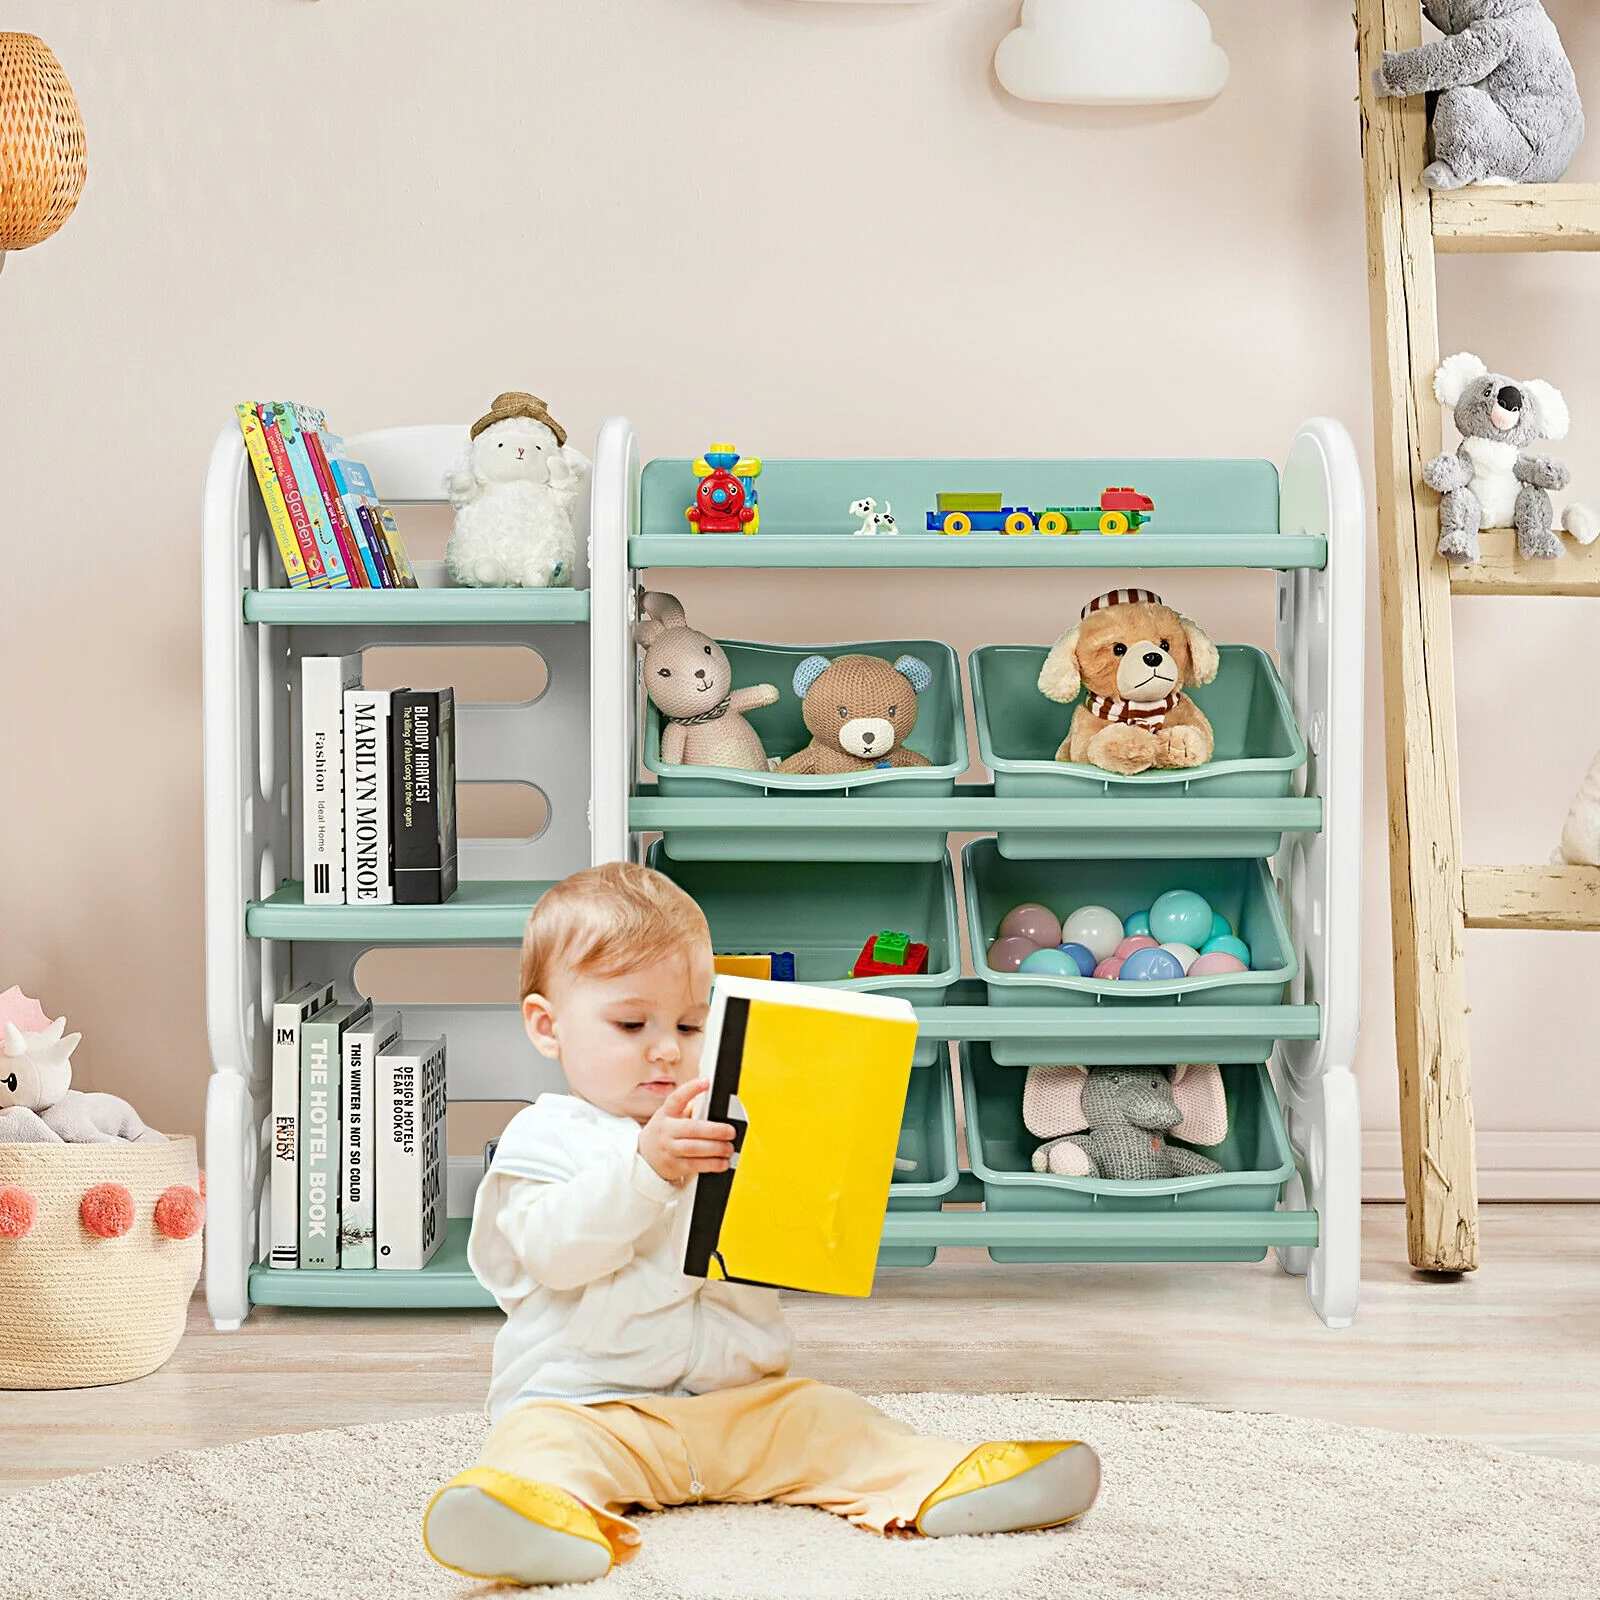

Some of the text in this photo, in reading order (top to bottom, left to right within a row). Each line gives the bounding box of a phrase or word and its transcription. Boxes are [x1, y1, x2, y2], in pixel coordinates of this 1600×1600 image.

[284, 475, 293, 489] the
[264, 481, 291, 549] animal homes
[285, 490, 312, 548] garden
[315, 732, 327, 792] Fashion
[402, 706, 413, 828] The killing of Falun Gong for their organs
[414, 706, 430, 803] BLOODY HARVEST
[318, 800, 326, 852] Ideal Home
[354, 703, 379, 900] MARILYN MONROE
[277, 1029, 294, 1042] IM
[350, 1043, 362, 1067] THIS
[350, 1069, 362, 1110] WINTER
[393, 1066, 404, 1095] YEAR
[422, 1046, 446, 1098] DESIGN
[350, 1113, 362, 1124] IS
[403, 1066, 414, 1153] DESIGN HOTELS
[422, 1082, 447, 1136] HOTELS
[276, 1116, 287, 1161] ENJOY
[286, 1116, 295, 1162] PERFECT
[308, 1039, 328, 1238] THE HOTEL BOOK
[350, 1127, 362, 1148] NOT
[350, 1150, 361, 1165] SO
[422, 1127, 439, 1173] YEAR
[422, 1162, 440, 1212] BOOK
